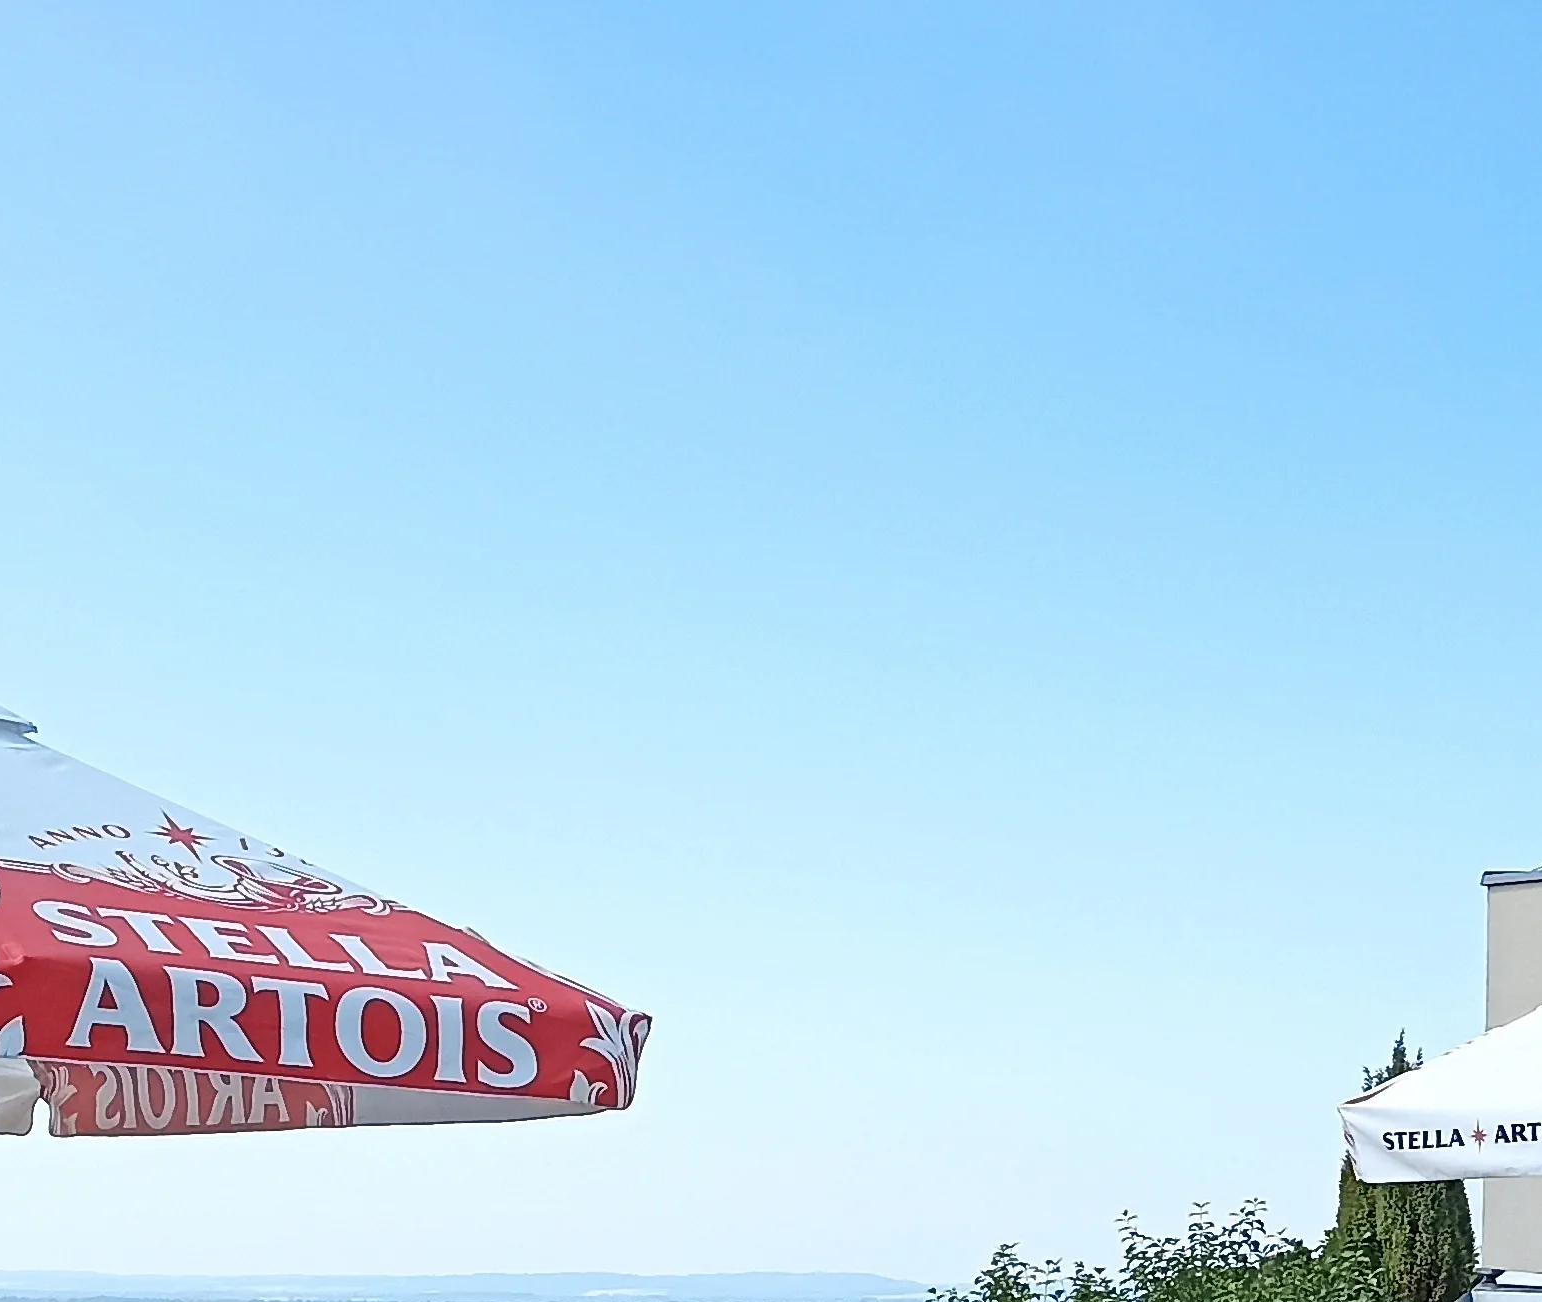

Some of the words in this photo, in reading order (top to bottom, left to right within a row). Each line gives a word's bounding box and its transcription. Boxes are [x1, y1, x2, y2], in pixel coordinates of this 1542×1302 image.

[28, 824, 131, 850] ANNO
[32, 900, 519, 991] STELLA
[1382, 1129, 1465, 1150] STELLA
